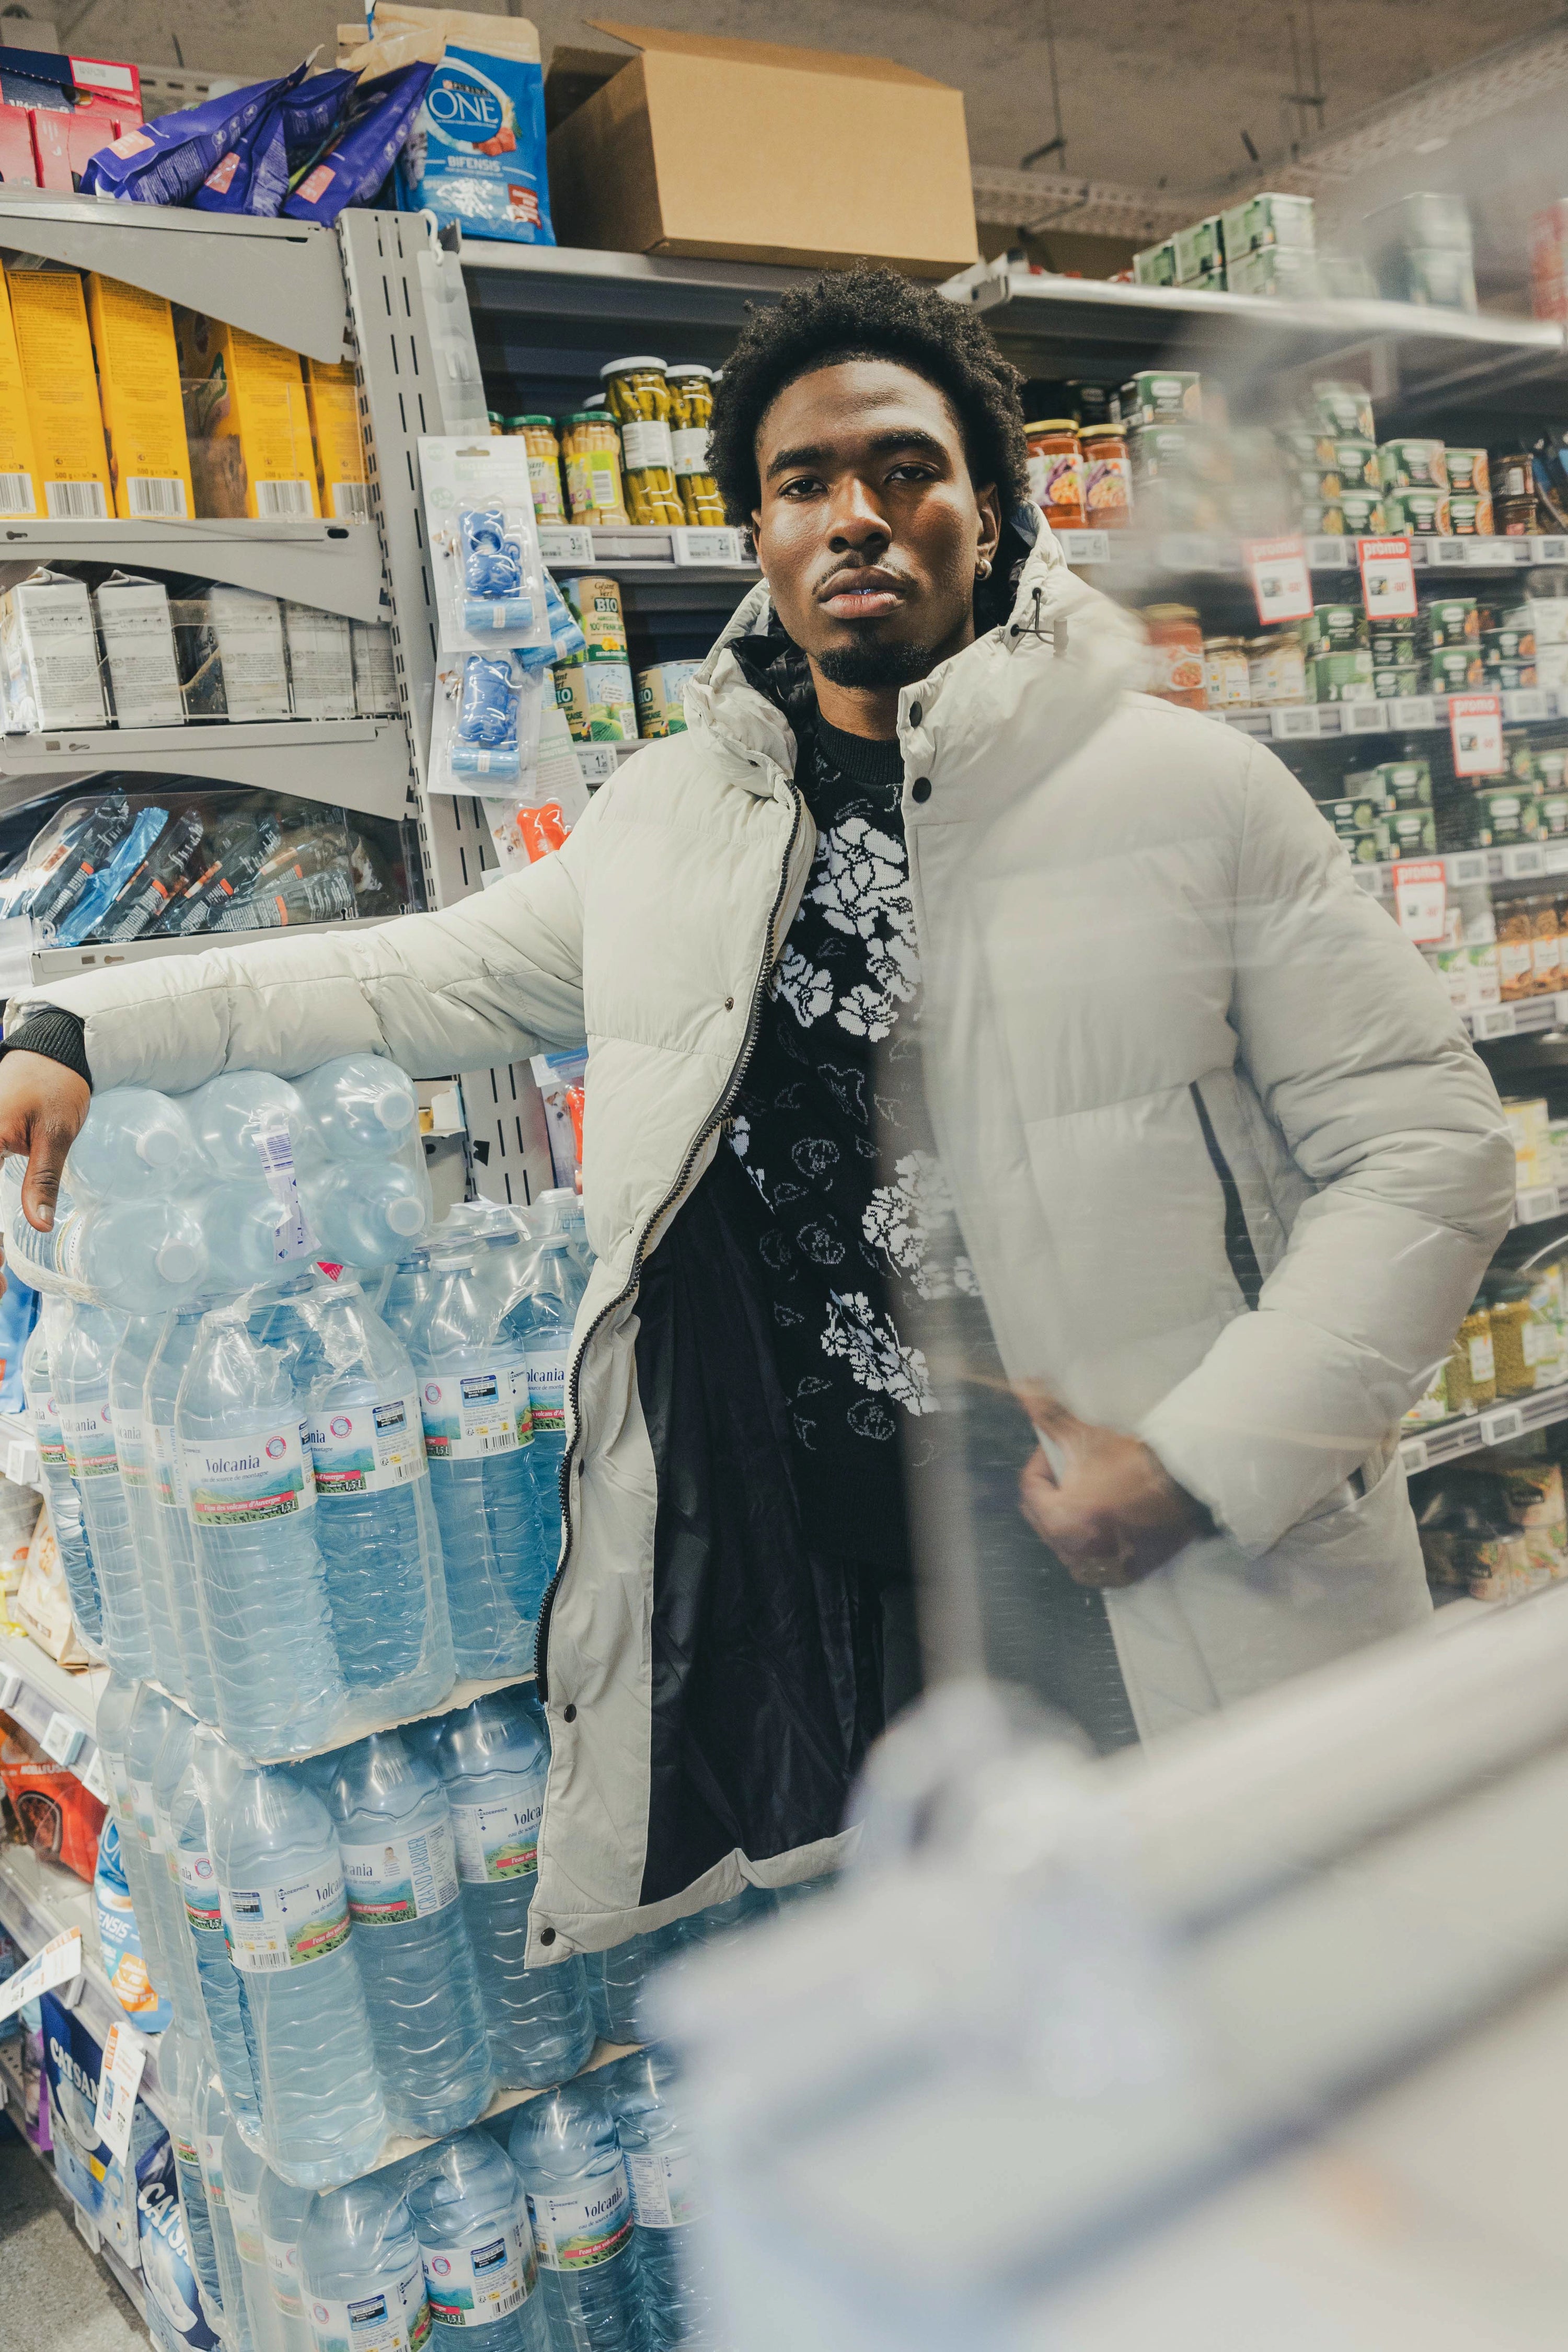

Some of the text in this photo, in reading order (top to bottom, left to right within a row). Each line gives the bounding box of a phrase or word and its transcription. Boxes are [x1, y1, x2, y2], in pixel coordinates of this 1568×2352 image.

[429, 88, 498, 123] ONE
[447, 156, 500, 172] BIFENSIS
[1363, 541, 1406, 561] promo
[596, 598, 617, 612] BIO
[557, 689, 572, 702] IO
[1453, 698, 1495, 717] promo
[567, 711, 583, 722] ÇAISE
[435, 1446, 449, 1456] 1,5 L
[205, 1455, 260, 1473] Volcania
[242, 1470, 269, 1479] montagne
[345, 1480, 355, 1491] 1,5
[358, 1480, 362, 1488] L
[249, 1495, 281, 1507] d'Auvergne
[281, 1503, 291, 1514] 1,5
[292, 1501, 296, 1509] L
[478, 1807, 508, 1816] LEADERPRICE
[511, 1855, 524, 1864] l'eau
[407, 1835, 437, 1911] GRAND BARBIER
[278, 1883, 310, 1897] LEADERPRICE
[98, 1909, 133, 1939] ENSIS
[313, 1936, 325, 1945] l'eau
[585, 2186, 622, 2218] Volcania
[447, 2314, 456, 2323] 1,5
